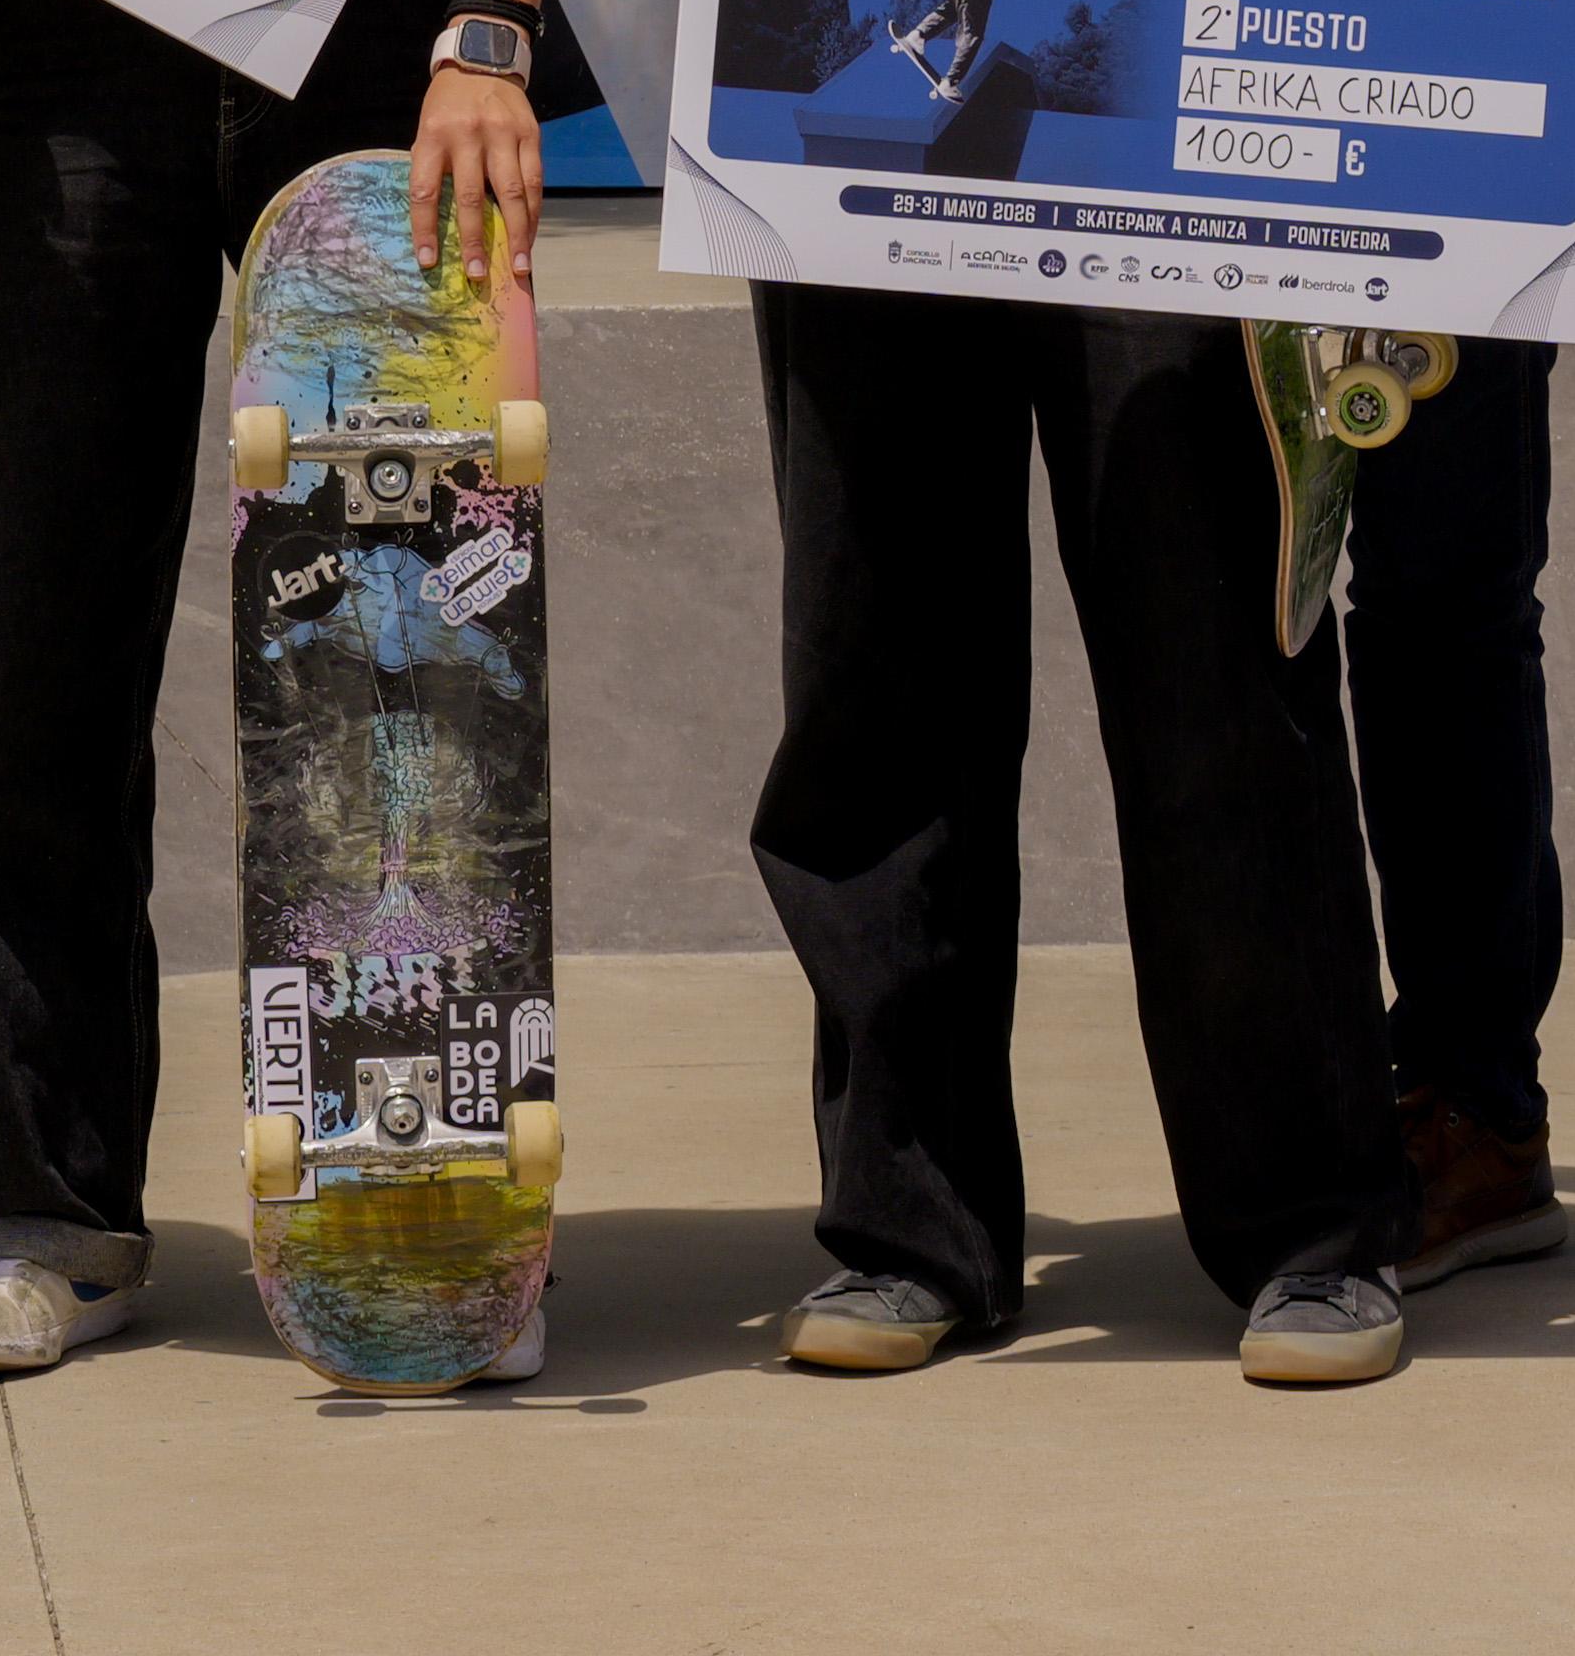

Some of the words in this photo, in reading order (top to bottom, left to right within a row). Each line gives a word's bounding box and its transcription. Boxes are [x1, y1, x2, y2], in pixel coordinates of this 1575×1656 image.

[1241, 7, 1367, 51] PUESTO
[1183, 66, 1322, 111] AFRIKA
[1338, 77, 1475, 120] CRIADO
[892, 193, 938, 215] 29-31
[943, 197, 988, 220] MAYO
[992, 201, 1036, 223] 2026
[1076, 208, 1166, 235] SKATEPARK
[1170, 214, 1183, 235] A
[1187, 215, 1248, 241] CANIZA
[1287, 224, 1391, 252] PONTEVEDRA
[1118, 273, 1140, 283] CNS
[1301, 277, 1355, 294] Iberdrola
[449, 1001, 498, 1030] LA
[449, 1039, 501, 1068] BO
[449, 1069, 498, 1096] DE
[449, 1096, 500, 1125] GA
